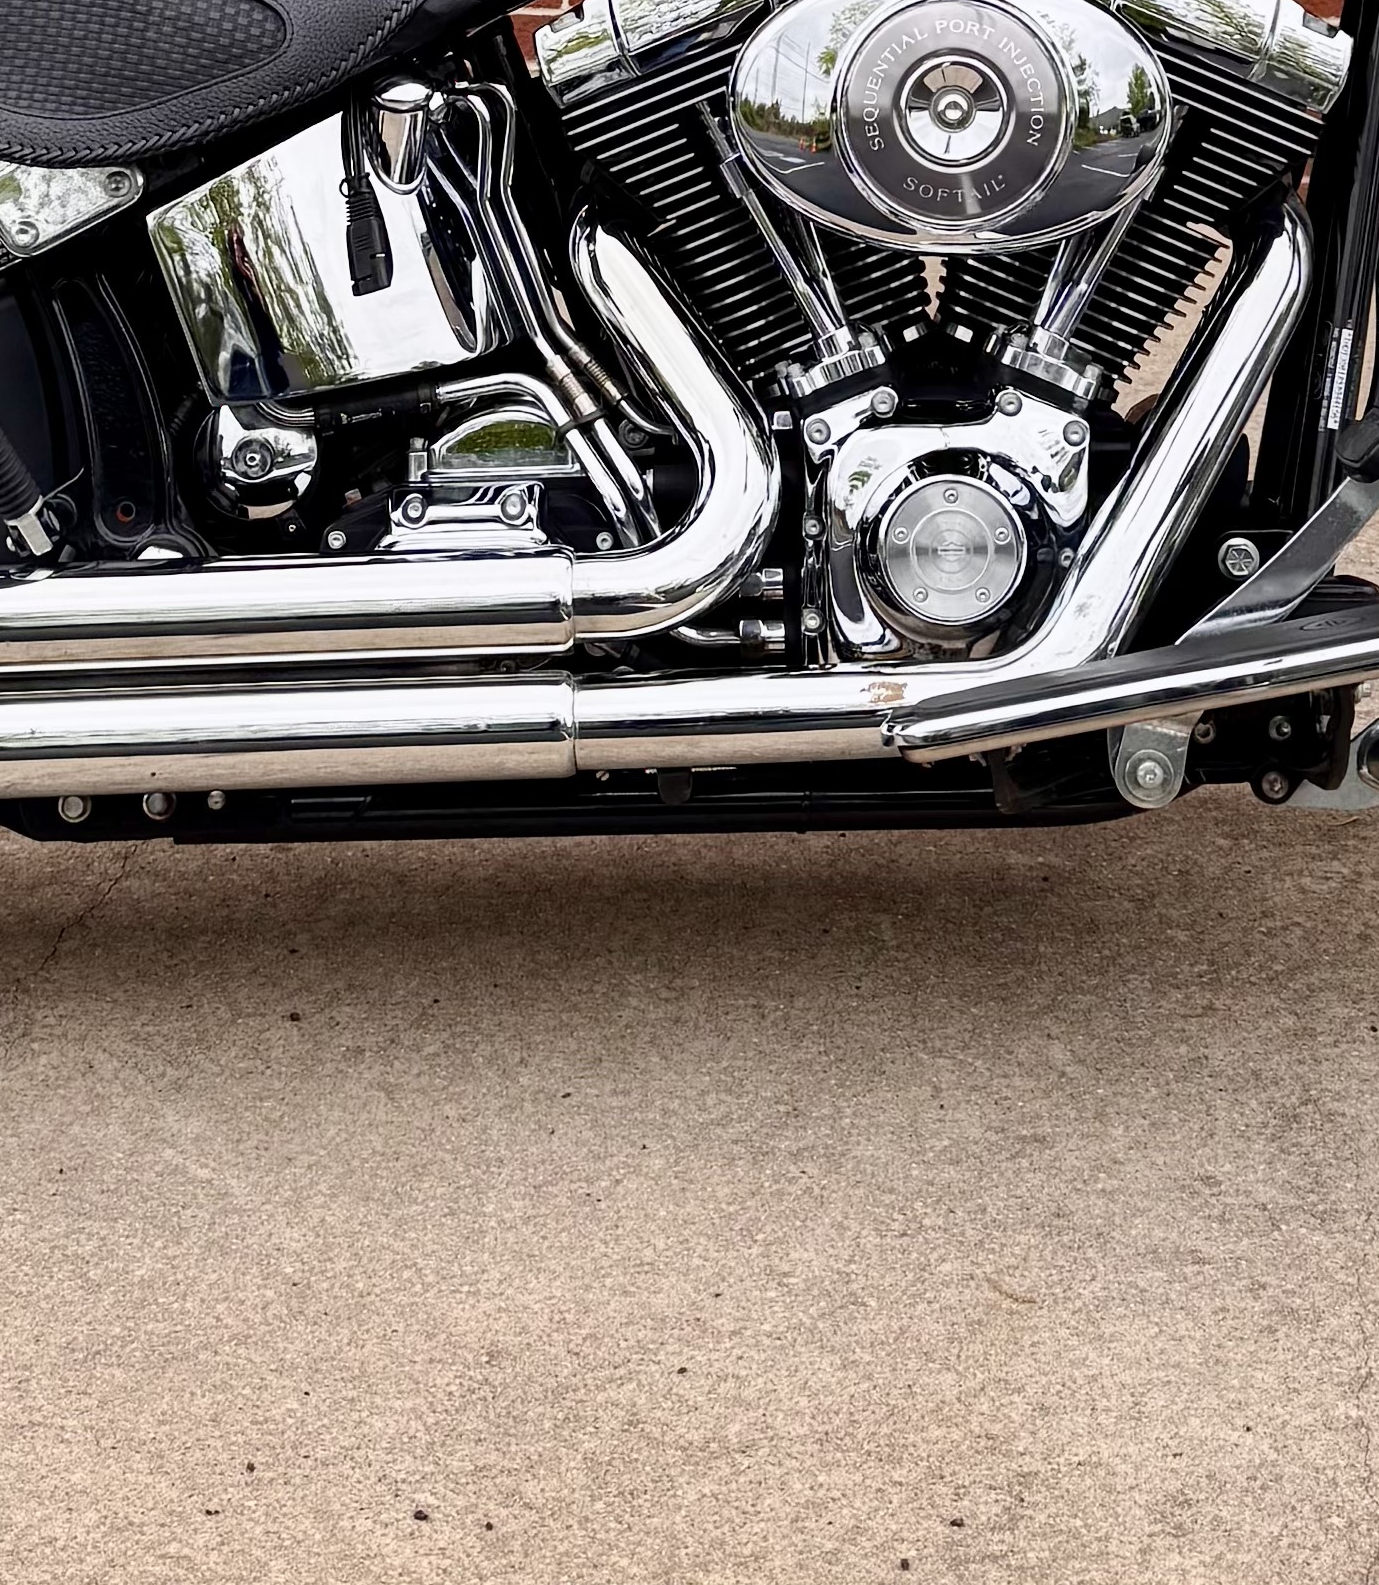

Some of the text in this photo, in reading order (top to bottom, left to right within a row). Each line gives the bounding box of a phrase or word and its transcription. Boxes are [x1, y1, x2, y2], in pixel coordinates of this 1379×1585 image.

[863, 19, 1046, 151] SEQUENTIAL PORT INJECTION
[903, 175, 1006, 203] SOFTAIL
